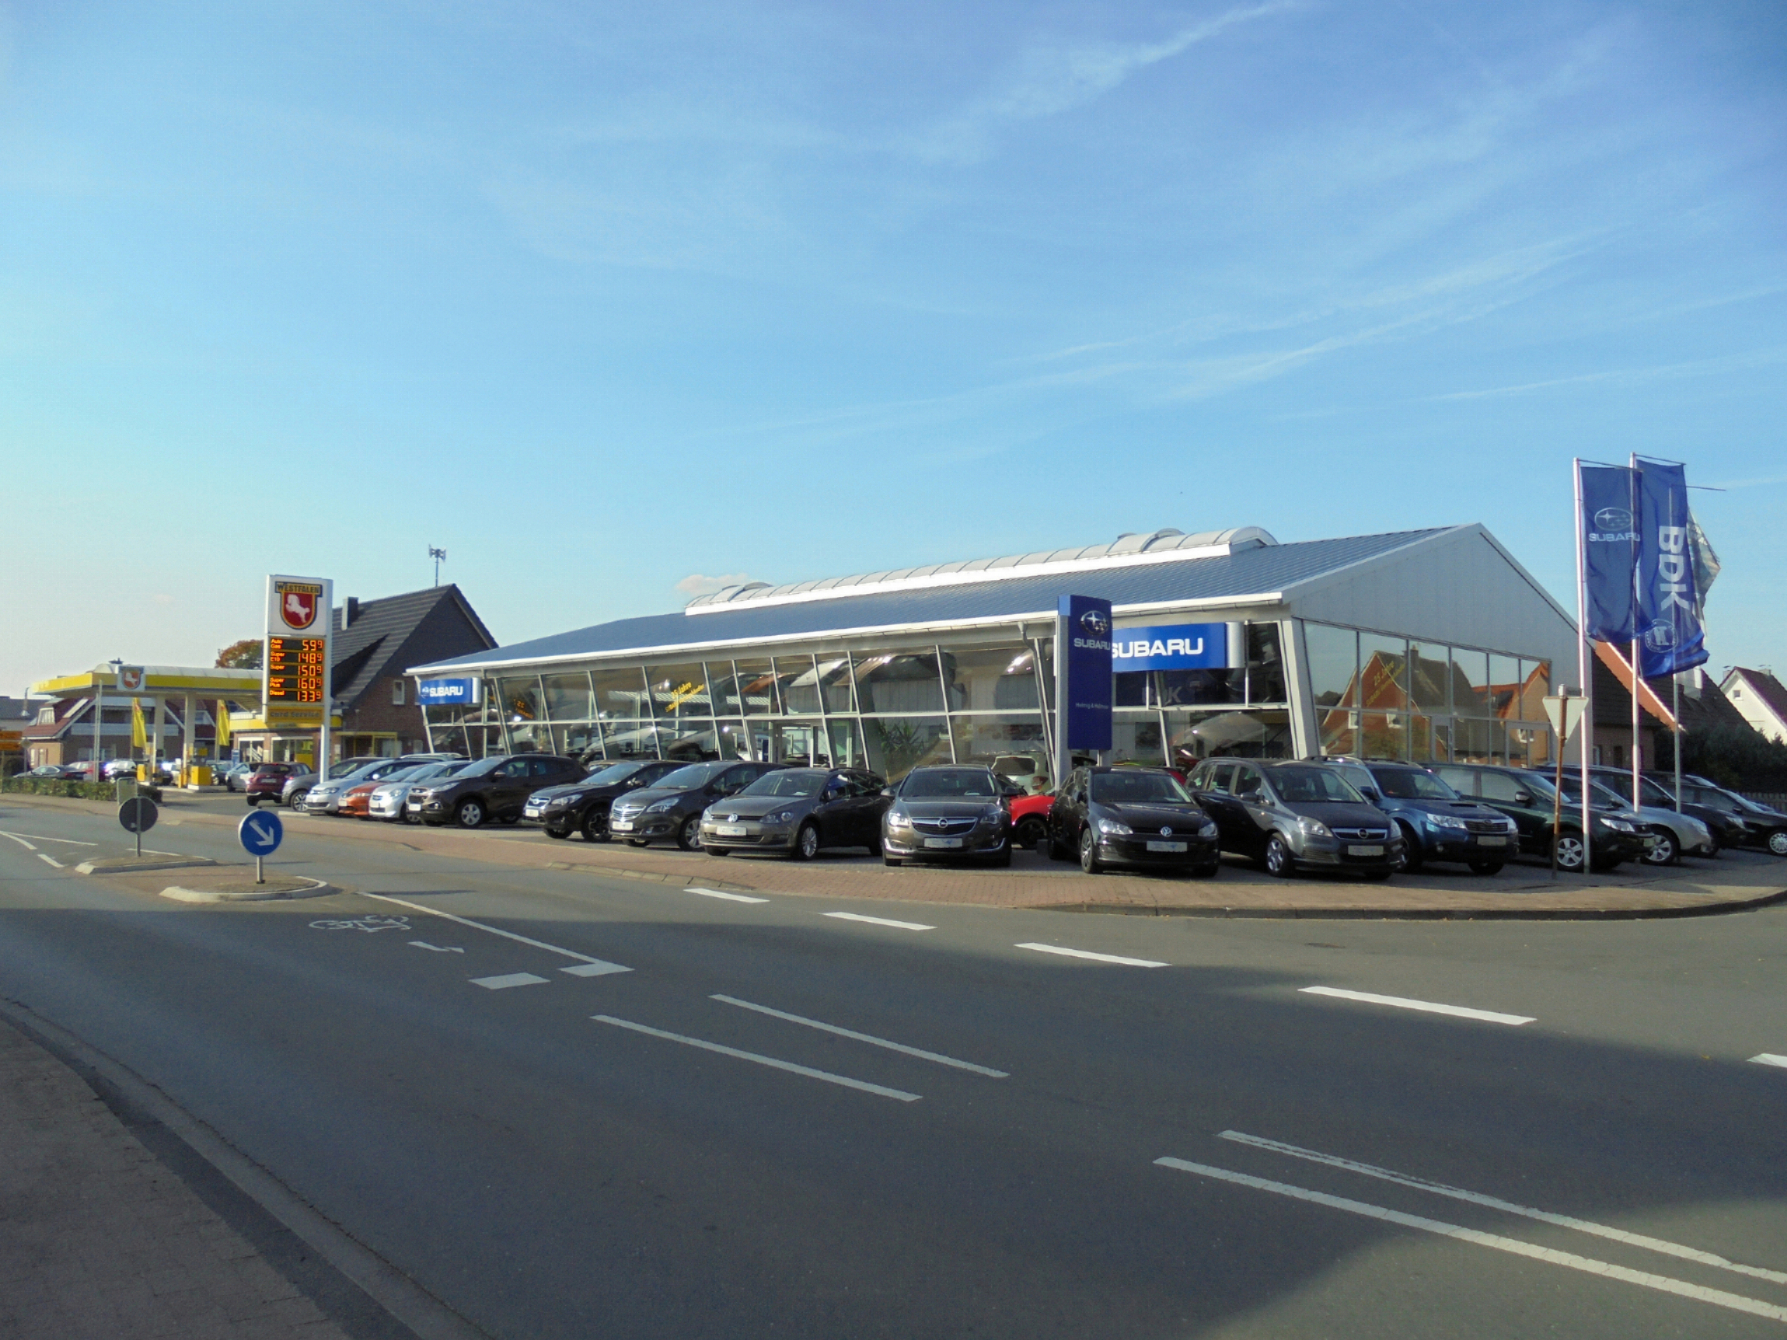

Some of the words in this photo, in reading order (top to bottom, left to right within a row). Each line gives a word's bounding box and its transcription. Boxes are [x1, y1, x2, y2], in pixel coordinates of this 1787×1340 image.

[1588, 532, 1640, 542] SUBARU
[1659, 526, 1690, 611] BDK
[277, 584, 320, 594] WESTFALEN
[1074, 637, 1111, 651] SUBARU
[429, 686, 464, 697] SUBARU
